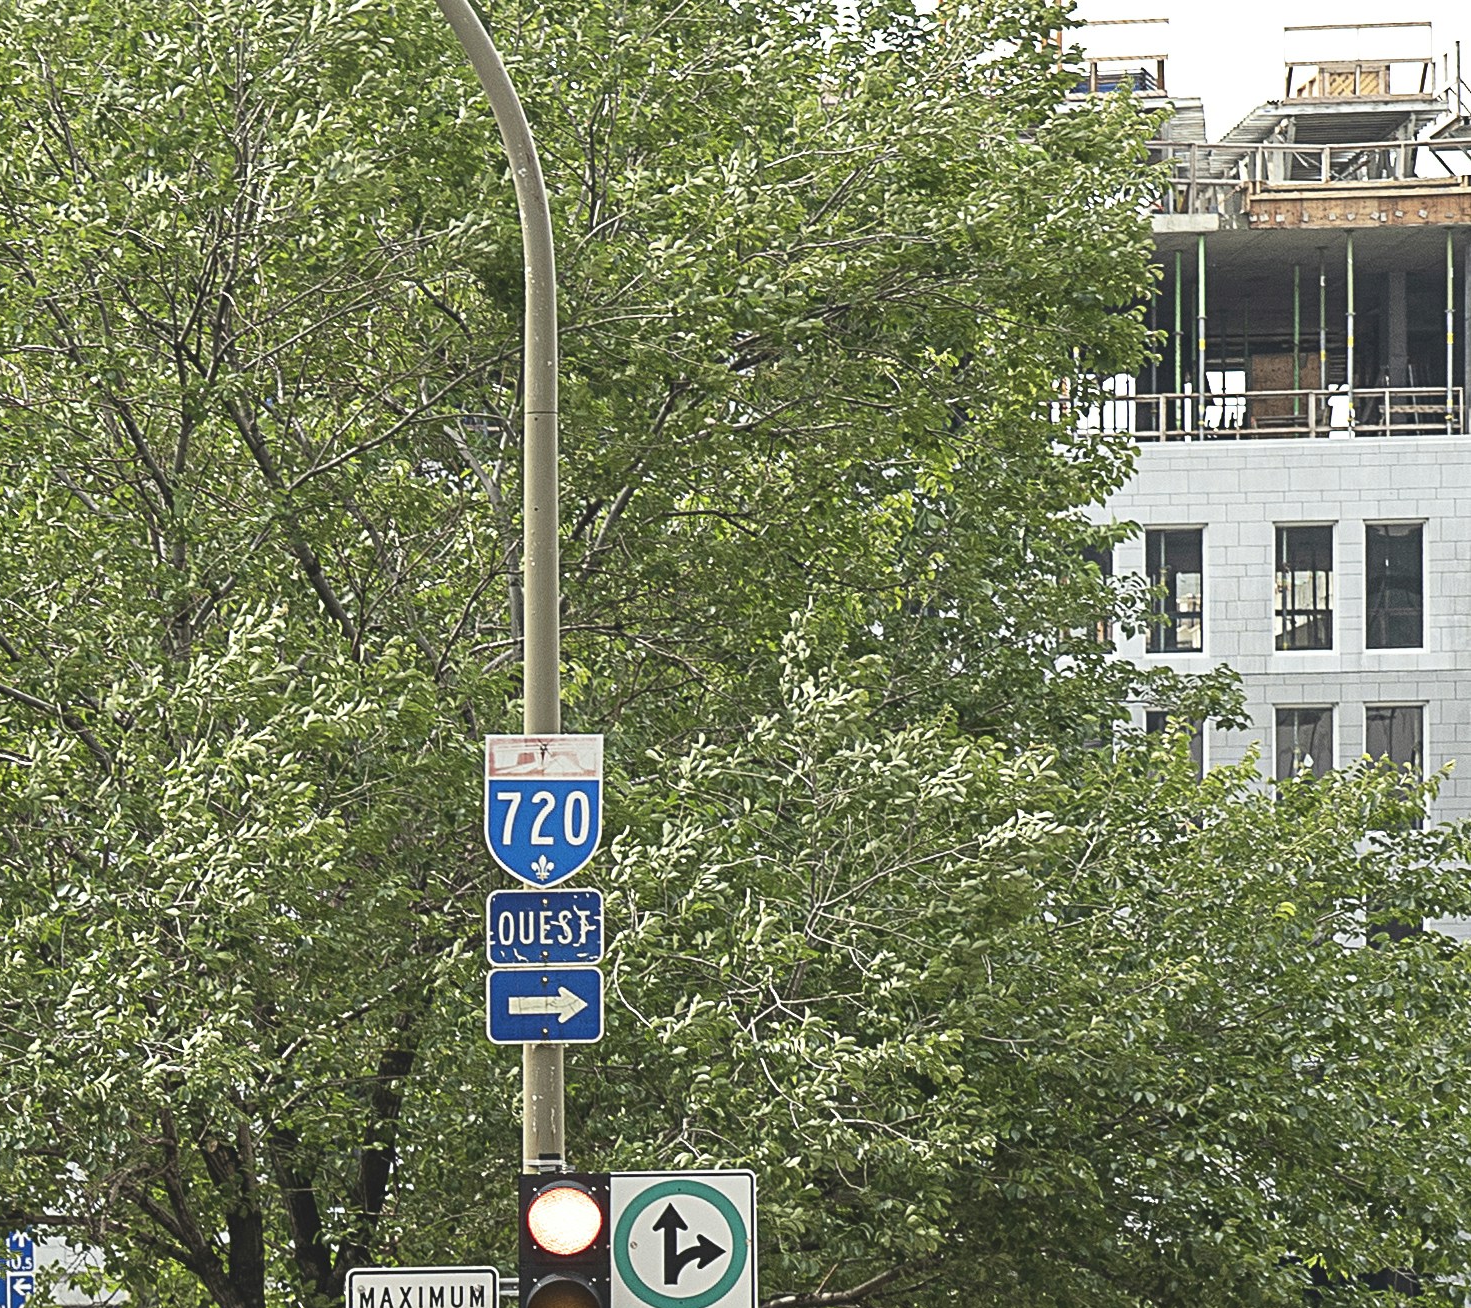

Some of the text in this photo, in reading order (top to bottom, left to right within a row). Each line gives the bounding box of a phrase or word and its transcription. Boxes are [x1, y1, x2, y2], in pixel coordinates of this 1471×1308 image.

[496, 790, 590, 846] 720
[498, 911, 591, 946] OUEST
[359, 1285, 485, 1308] MAXIMUM
